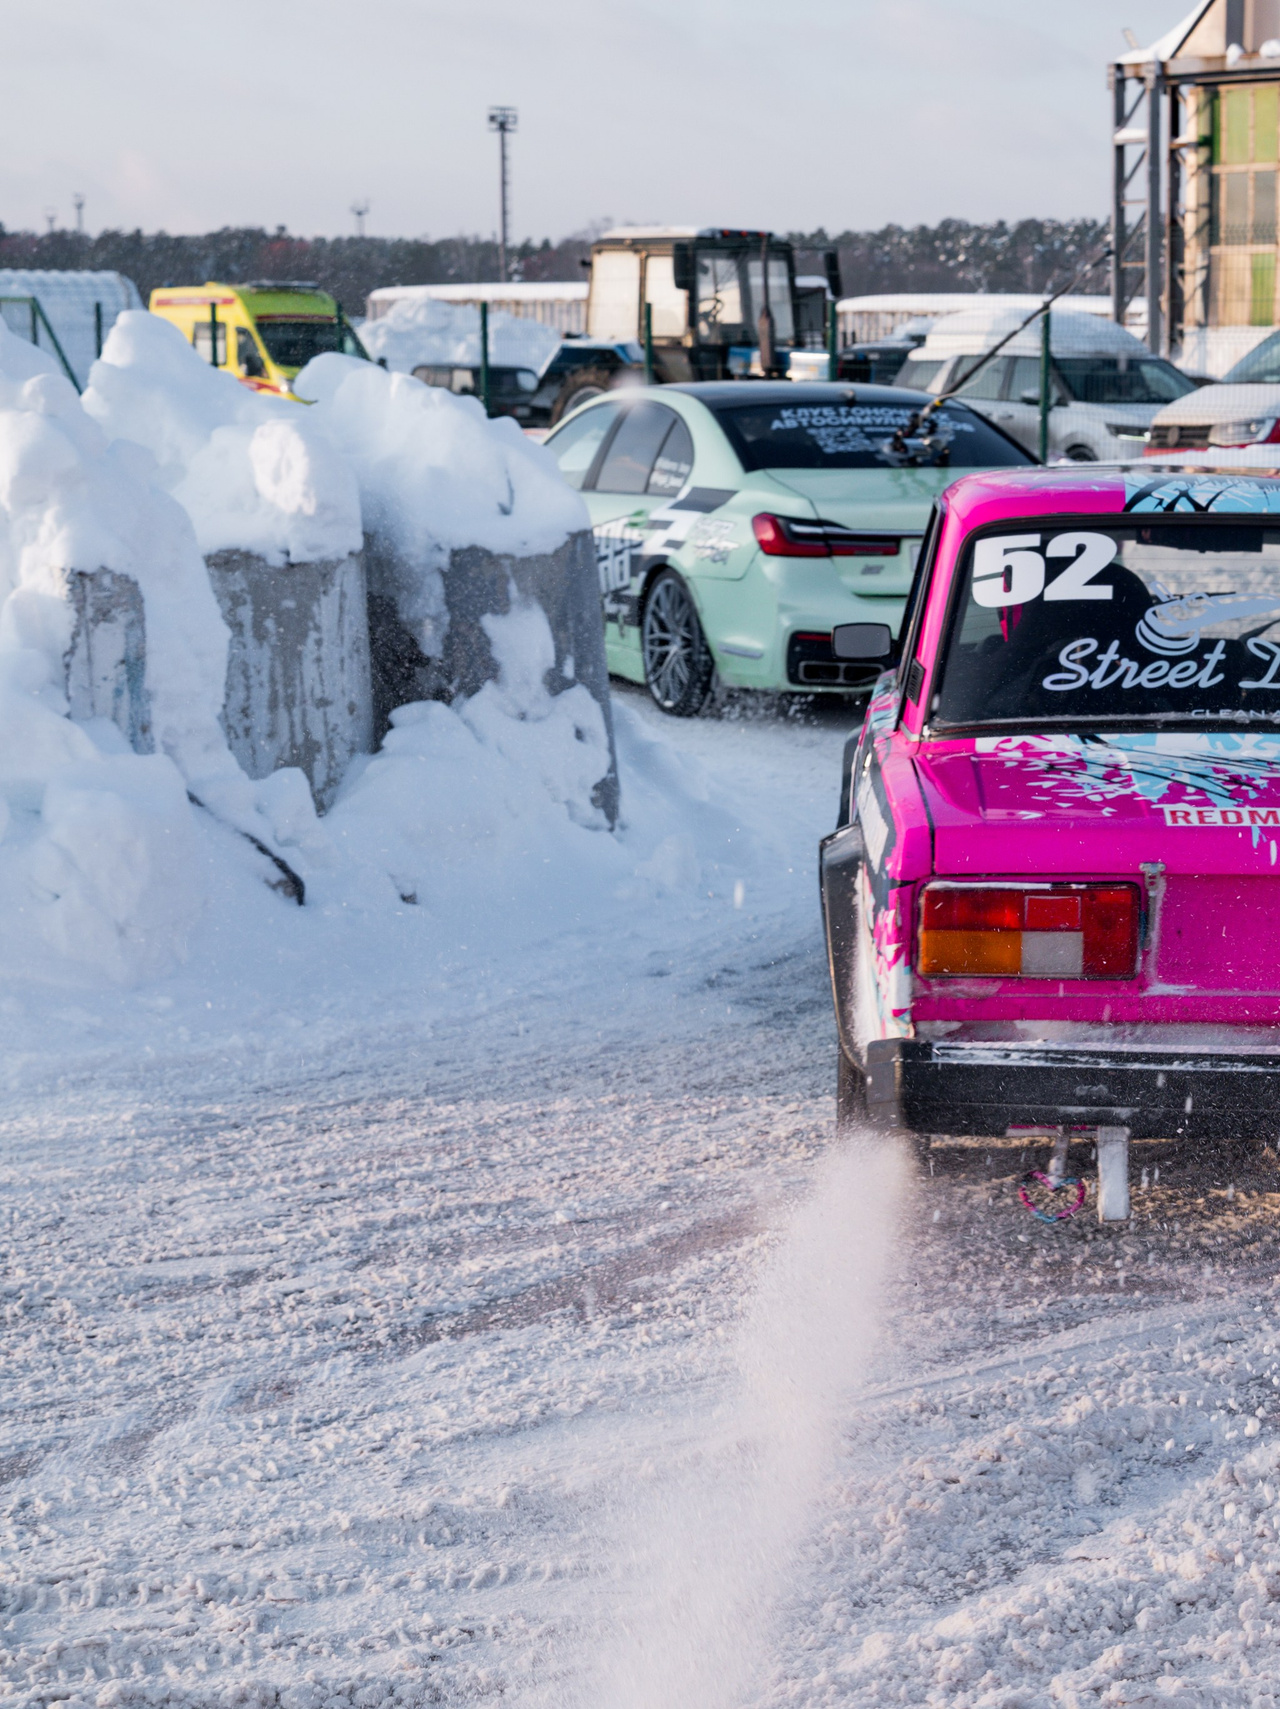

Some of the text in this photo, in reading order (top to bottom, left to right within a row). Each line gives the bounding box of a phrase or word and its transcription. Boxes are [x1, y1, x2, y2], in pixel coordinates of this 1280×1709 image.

[779, 406, 836, 419] КЛУБ
[972, 531, 1118, 608] 52
[1041, 637, 1226, 691] Street
[1190, 708, 1267, 720] CLEAN
